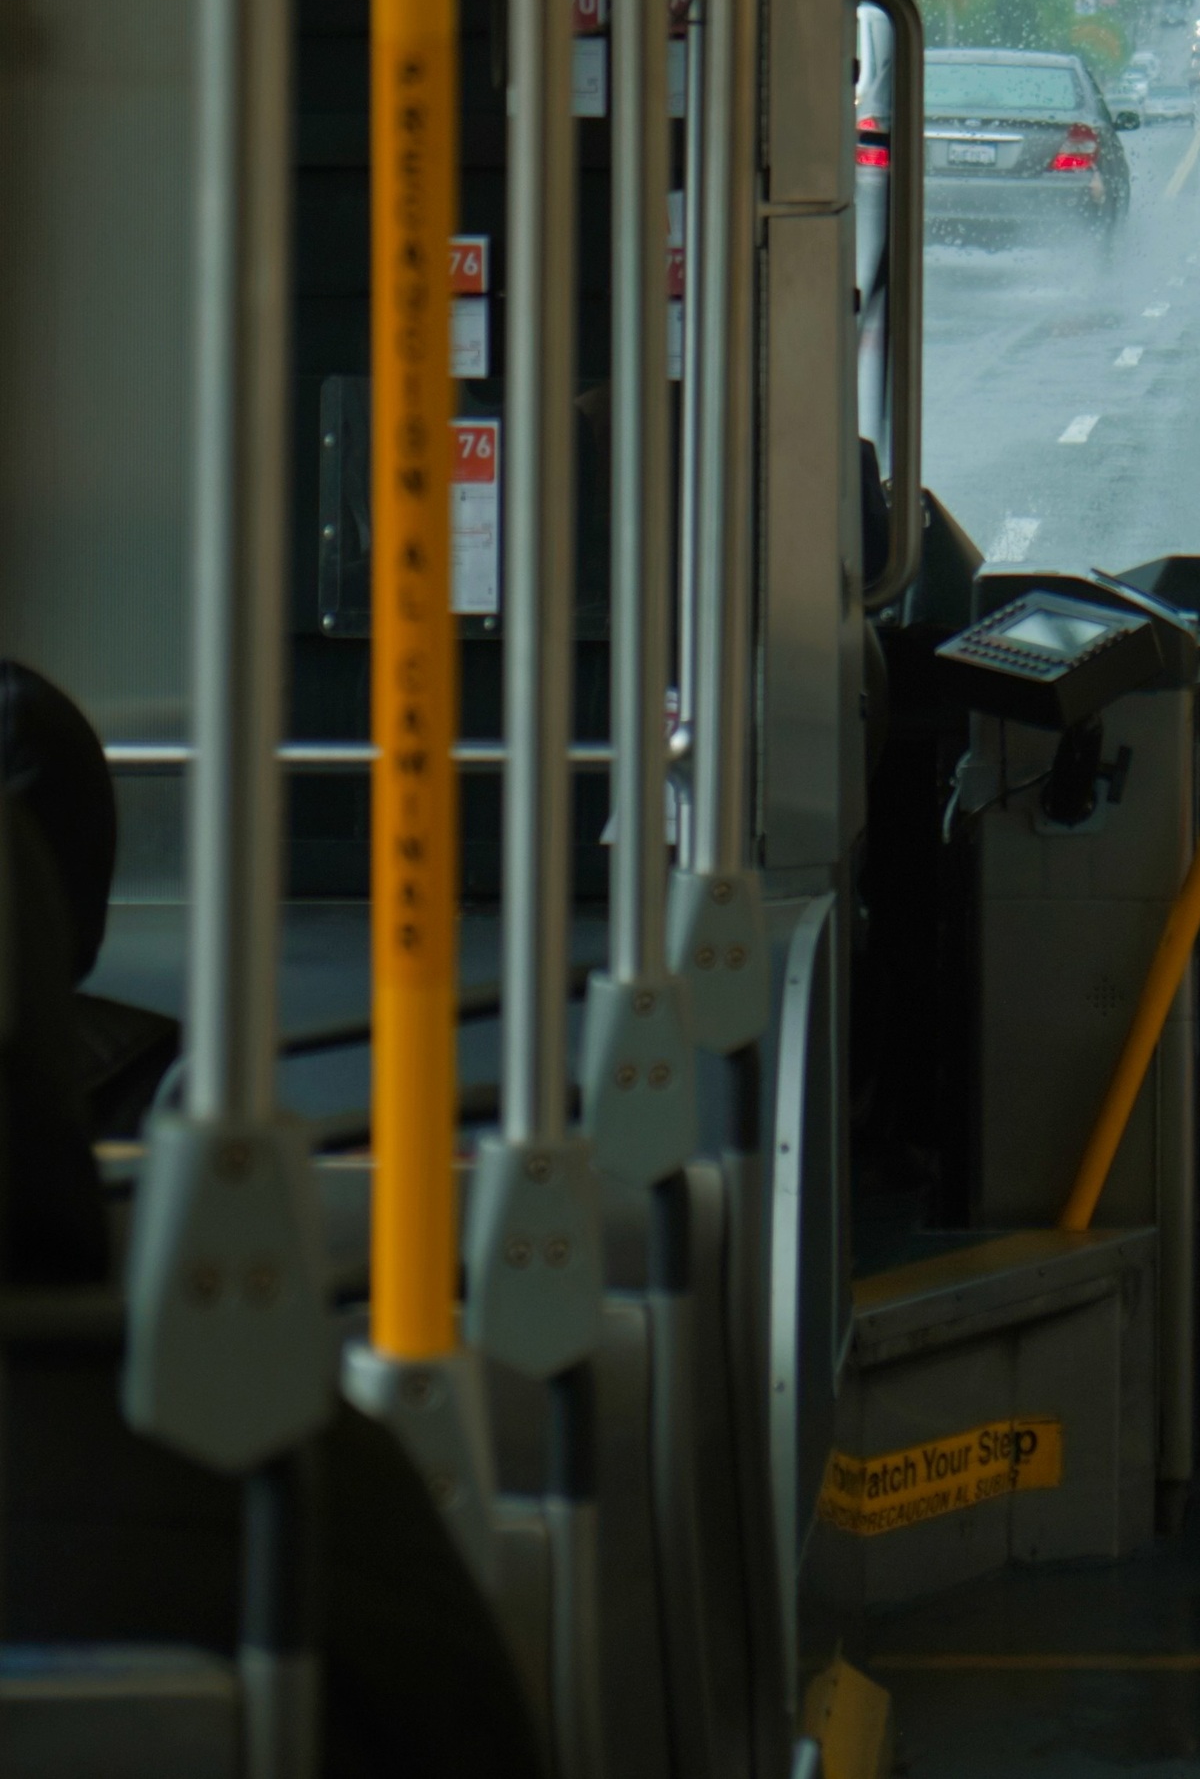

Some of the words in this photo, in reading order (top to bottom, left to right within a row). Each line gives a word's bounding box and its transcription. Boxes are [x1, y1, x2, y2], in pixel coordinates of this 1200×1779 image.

[448, 250, 479, 277] 76
[458, 433, 492, 460] 76
[922, 1444, 973, 1482] Your
[977, 1429, 1038, 1467] Step
[952, 1484, 971, 1508] AL
